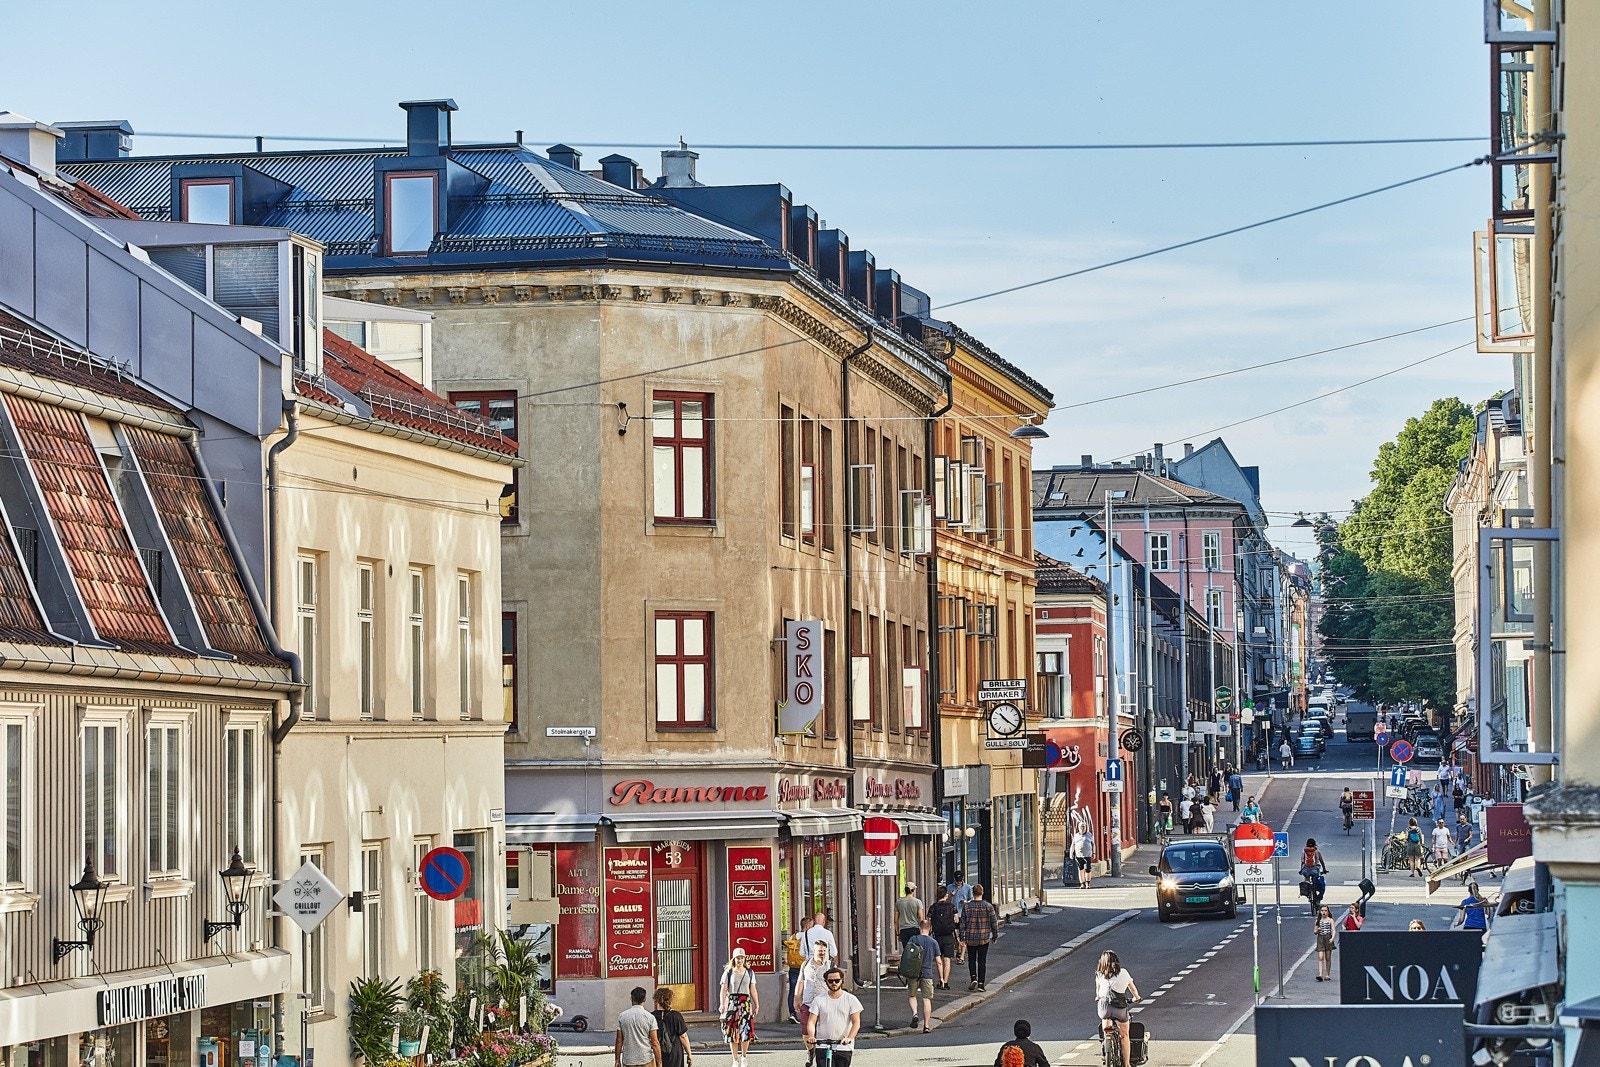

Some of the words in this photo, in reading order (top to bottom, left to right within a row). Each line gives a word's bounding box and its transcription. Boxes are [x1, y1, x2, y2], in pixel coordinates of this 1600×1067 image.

[795, 627, 813, 704] SKO
[981, 690, 1019, 698] URMAKER
[609, 779, 768, 806] Ramona
[666, 852, 682, 865] 53
[568, 869, 584, 877] ALT
[559, 904, 599, 914] herresko
[609, 954, 648, 965] Ramona
[1363, 964, 1460, 1000] NOA
[103, 984, 147, 1026] CHILLOUT
[150, 977, 181, 1017] TRAVEL
